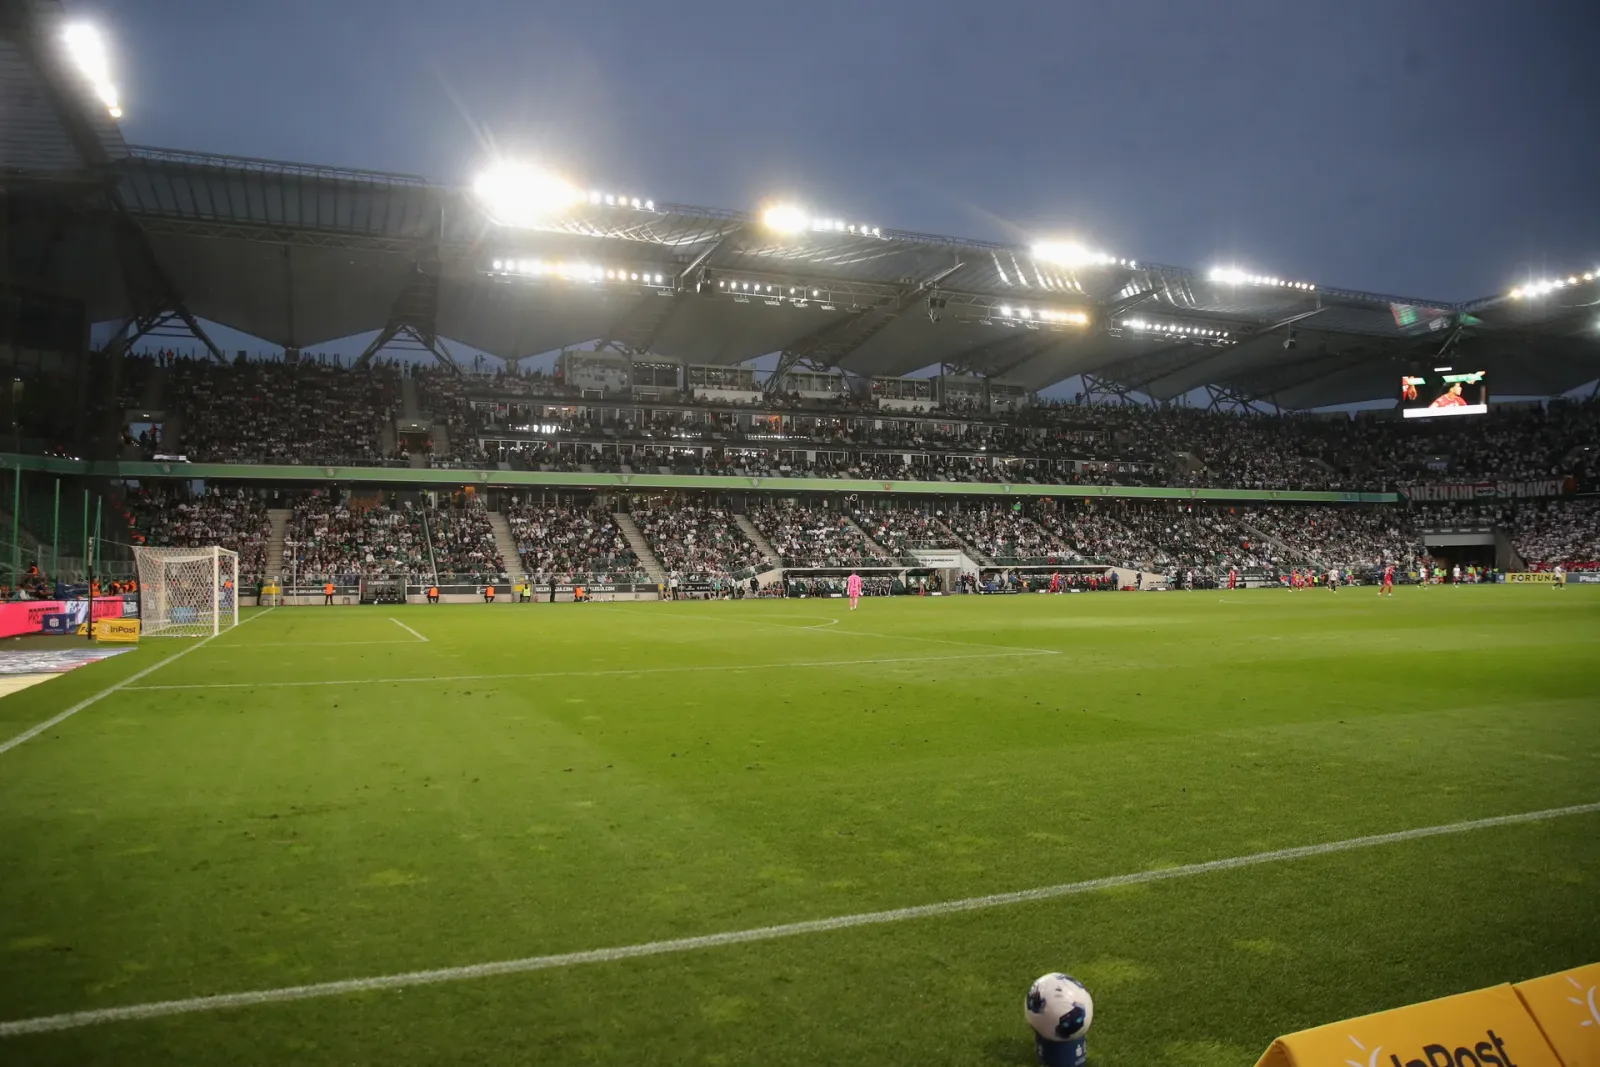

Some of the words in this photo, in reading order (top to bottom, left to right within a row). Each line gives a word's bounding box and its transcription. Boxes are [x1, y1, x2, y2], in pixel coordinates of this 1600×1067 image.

[1410, 485, 1474, 501] NIEZNANI
[1496, 480, 1565, 498] SPRAWCY
[110, 626, 136, 634] InPost
